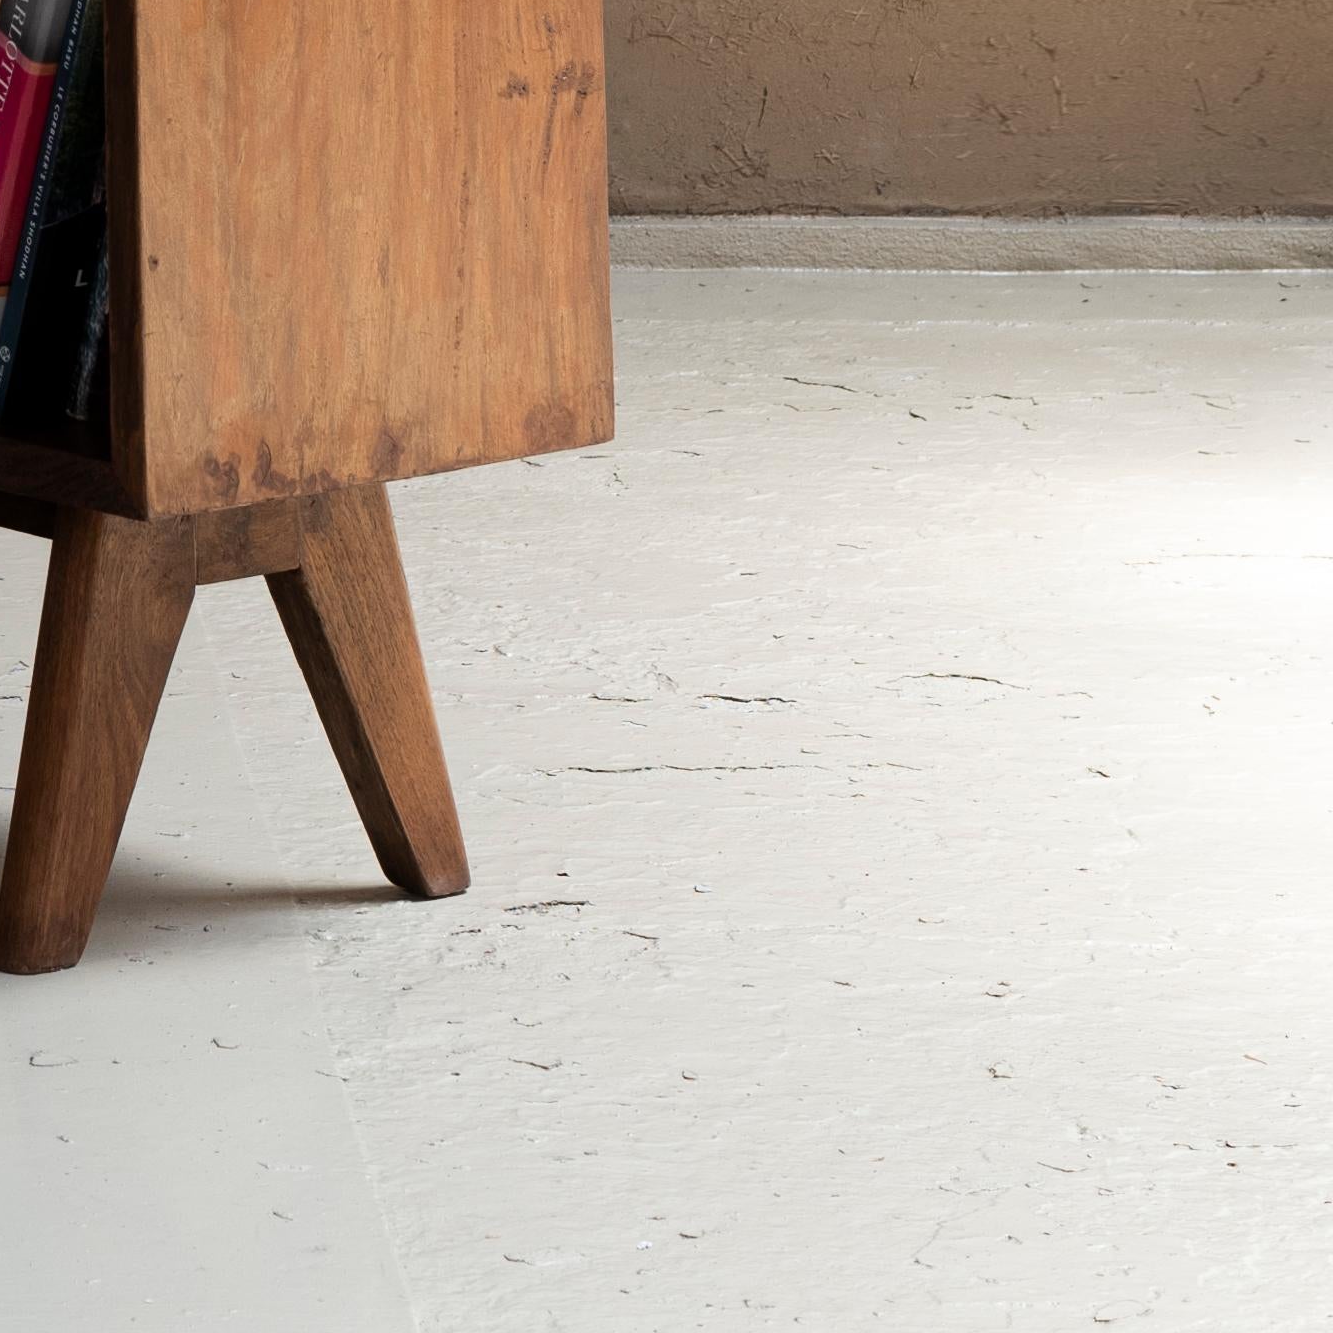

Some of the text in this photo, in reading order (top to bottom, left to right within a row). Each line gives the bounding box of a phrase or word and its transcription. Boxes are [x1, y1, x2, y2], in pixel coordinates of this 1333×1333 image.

[62, 38, 75, 71] BASU
[56, 85, 66, 100] LE
[39, 103, 61, 182] CORBUSIER'S
[31, 185, 45, 217] VILLA
[18, 219, 37, 280] SHODHAN
